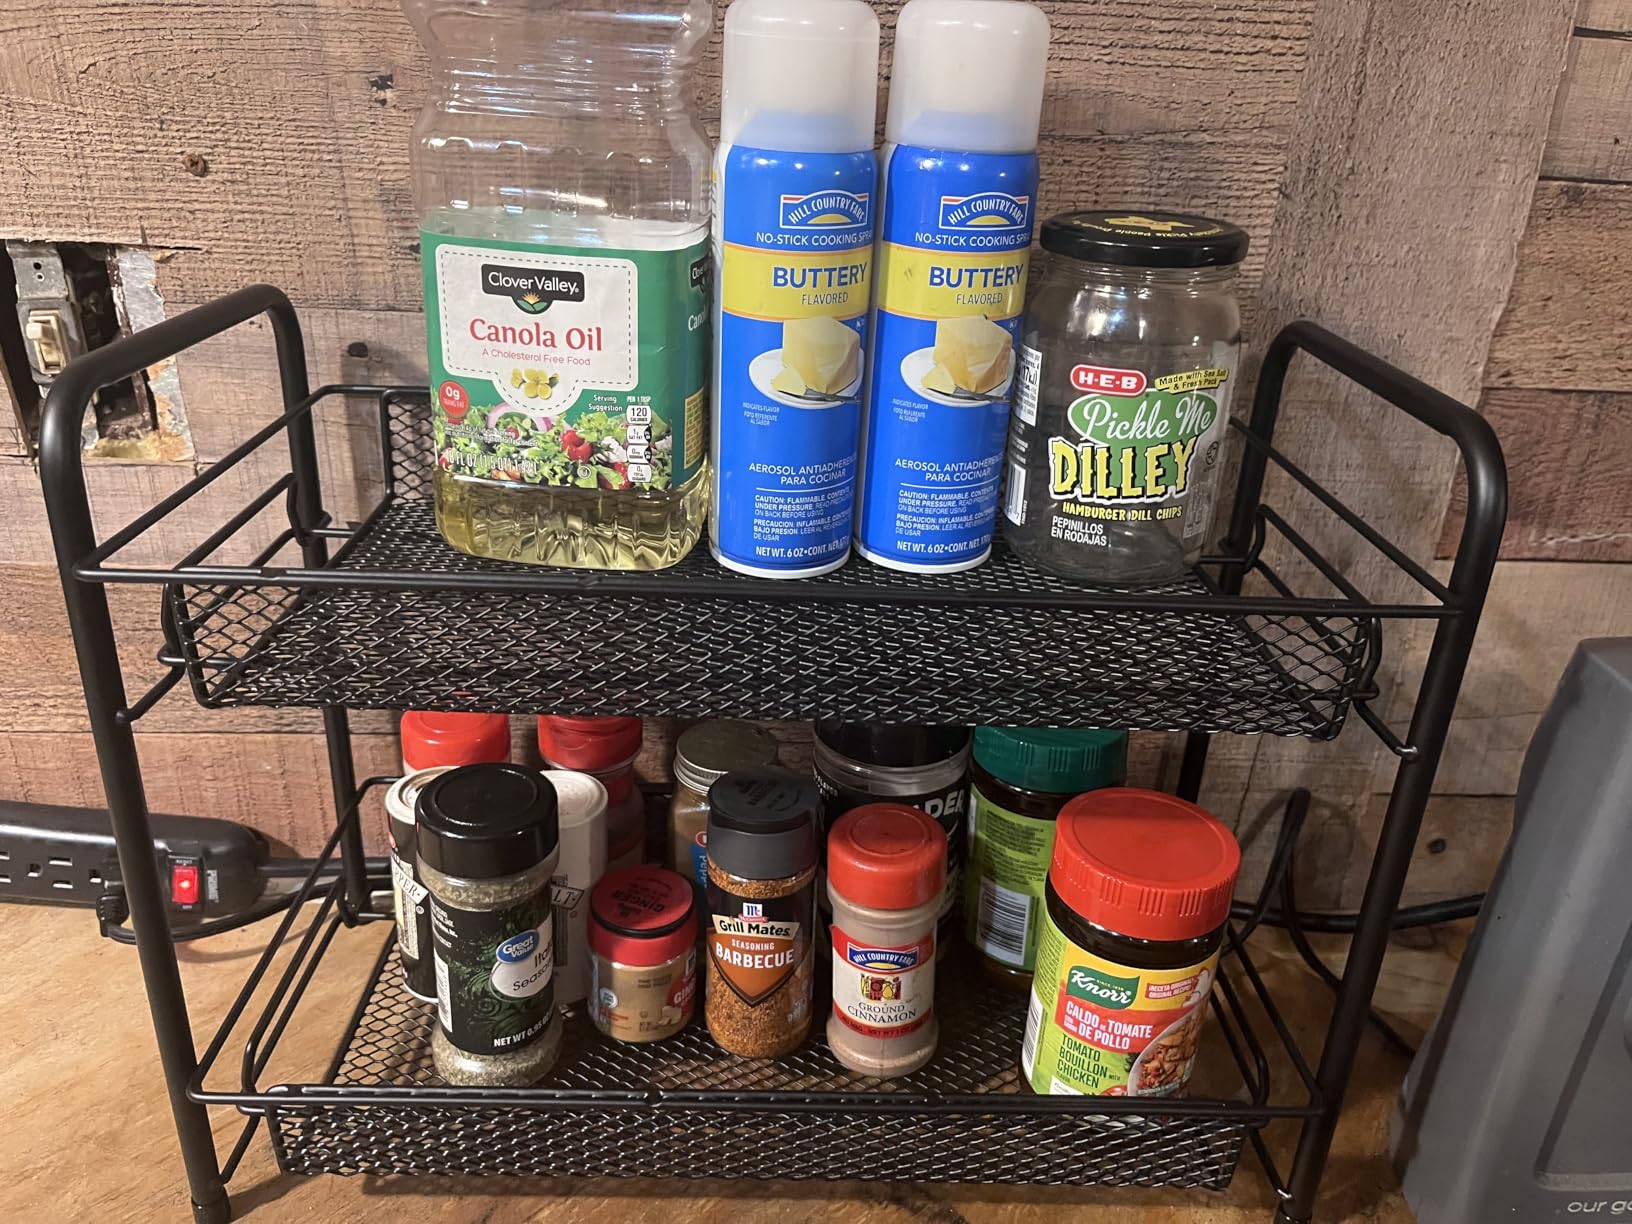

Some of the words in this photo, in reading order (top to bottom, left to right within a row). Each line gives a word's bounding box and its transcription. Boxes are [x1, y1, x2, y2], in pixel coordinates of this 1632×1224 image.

[788, 207, 811, 225] HILL
[811, 197, 850, 212] COUNTRY
[850, 203, 865, 222] FARE
[947, 207, 970, 225] HILL
[970, 198, 1010, 213] COUNTRY
[1010, 204, 1025, 223] FARE
[756, 231, 808, 246] NO-STICK
[811, 234, 857, 246] COOKING
[915, 231, 966, 246] NO-STICK
[969, 234, 1015, 247] COOKING
[772, 262, 867, 289] BUTTERY
[929, 264, 1024, 289] BUTTERY
[801, 292, 849, 305] FLAVORED
[956, 292, 1003, 305] FLAVORED
[469, 318, 557, 349] Canola
[565, 326, 602, 351] Oil
[482, 348, 489, 357] A
[490, 349, 542, 362] Cholesterol
[543, 355, 565, 364] Free
[567, 356, 591, 366] Food
[1159, 375, 1183, 387] Made
[1185, 370, 1201, 380] with
[1203, 369, 1216, 378] Sea
[1173, 382, 1179, 391] &
[1182, 380, 1202, 389] Fresh
[445, 386, 460, 400] 0g
[593, 394, 617, 403] Serving
[588, 403, 623, 412] Suggestion
[631, 407, 648, 417] 120
[1080, 399, 1171, 441] Pickle
[1175, 396, 1212, 436] Me
[749, 462, 796, 475] AEROSOL
[895, 458, 941, 472] AEROSOL
[1051, 436, 1199, 498] DILLEY
[780, 476, 807, 485] PARA
[809, 468, 846, 484] COCINAR
[925, 472, 951, 482] PARA
[953, 467, 991, 482] COCINAR
[755, 502, 777, 511] UNDER
[898, 497, 921, 506] UNDER
[781, 510, 806, 519] BEFORE
[907, 506, 924, 514] BACK
[924, 506, 949, 515] BEFORE
[1062, 502, 1127, 521] HAMBURGER
[1130, 508, 1153, 521] DILL
[1156, 506, 1183, 520] CHIPS
[753, 525, 770, 533] BAJO
[895, 520, 912, 528] BAJO
[1052, 516, 1104, 535] PEPINILLOS
[1051, 526, 1063, 539] EN
[1064, 529, 1107, 547] RODAJAS
[755, 546, 771, 557] NET
[772, 548, 786, 558] WT.
[786, 548, 792, 558] 6
[793, 547, 803, 557] OZ
[896, 540, 912, 551] NET
[912, 542, 926, 553] WT.
[927, 543, 933, 553] 6
[933, 543, 944, 553] OZ
[948, 541, 968, 553] CONT.
[720, 920, 744, 933] Grill
[748, 923, 790, 936] Mates
[503, 935, 533, 954] Great
[511, 943, 534, 958] Value
[731, 939, 775, 950] SEASONING
[715, 942, 795, 969] BARBECUE
[853, 953, 867, 963] HILL
[867, 952, 899, 962] COUNTRY
[899, 956, 914, 966] FARE
[1070, 969, 1133, 1005] Knorr
[847, 1005, 916, 1024] CINNAMON
[858, 1001, 905, 1014] GROUND
[1066, 1001, 1100, 1028] CALDO
[1107, 1019, 1153, 1038] TOMATE
[493, 1036, 511, 1048] NET
[512, 1031, 526, 1043] WT
[1078, 1022, 1093, 1040] DE
[1093, 1029, 1130, 1050] POLLO
[1062, 1033, 1101, 1062] TOMATO
[1060, 1046, 1108, 1079] BOUILLON
[1057, 1058, 1100, 1089] CHICKEN
[1567, 1201, 1608, 1213] our
